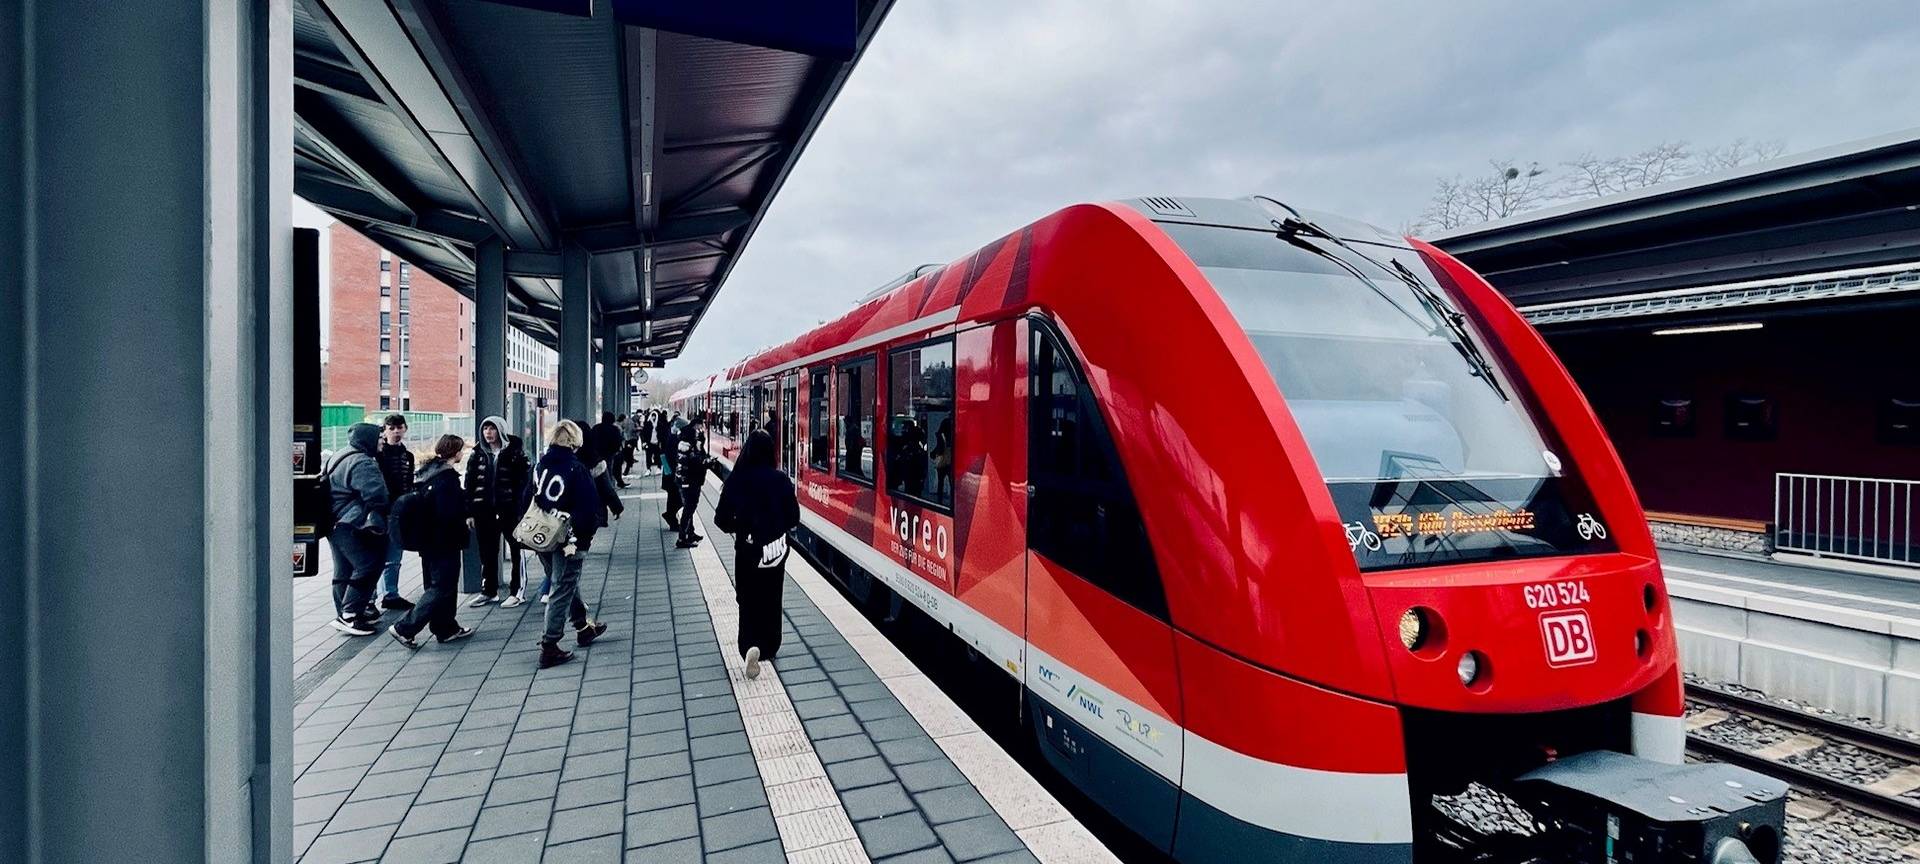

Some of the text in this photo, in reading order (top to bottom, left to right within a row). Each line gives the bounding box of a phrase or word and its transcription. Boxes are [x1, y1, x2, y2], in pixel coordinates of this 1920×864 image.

[890, 505, 947, 560] vareo
[926, 559, 947, 581] REGION
[1523, 581, 1590, 608] 620 524
[1548, 619, 1589, 657] DB
[1080, 695, 1104, 720] NWL
